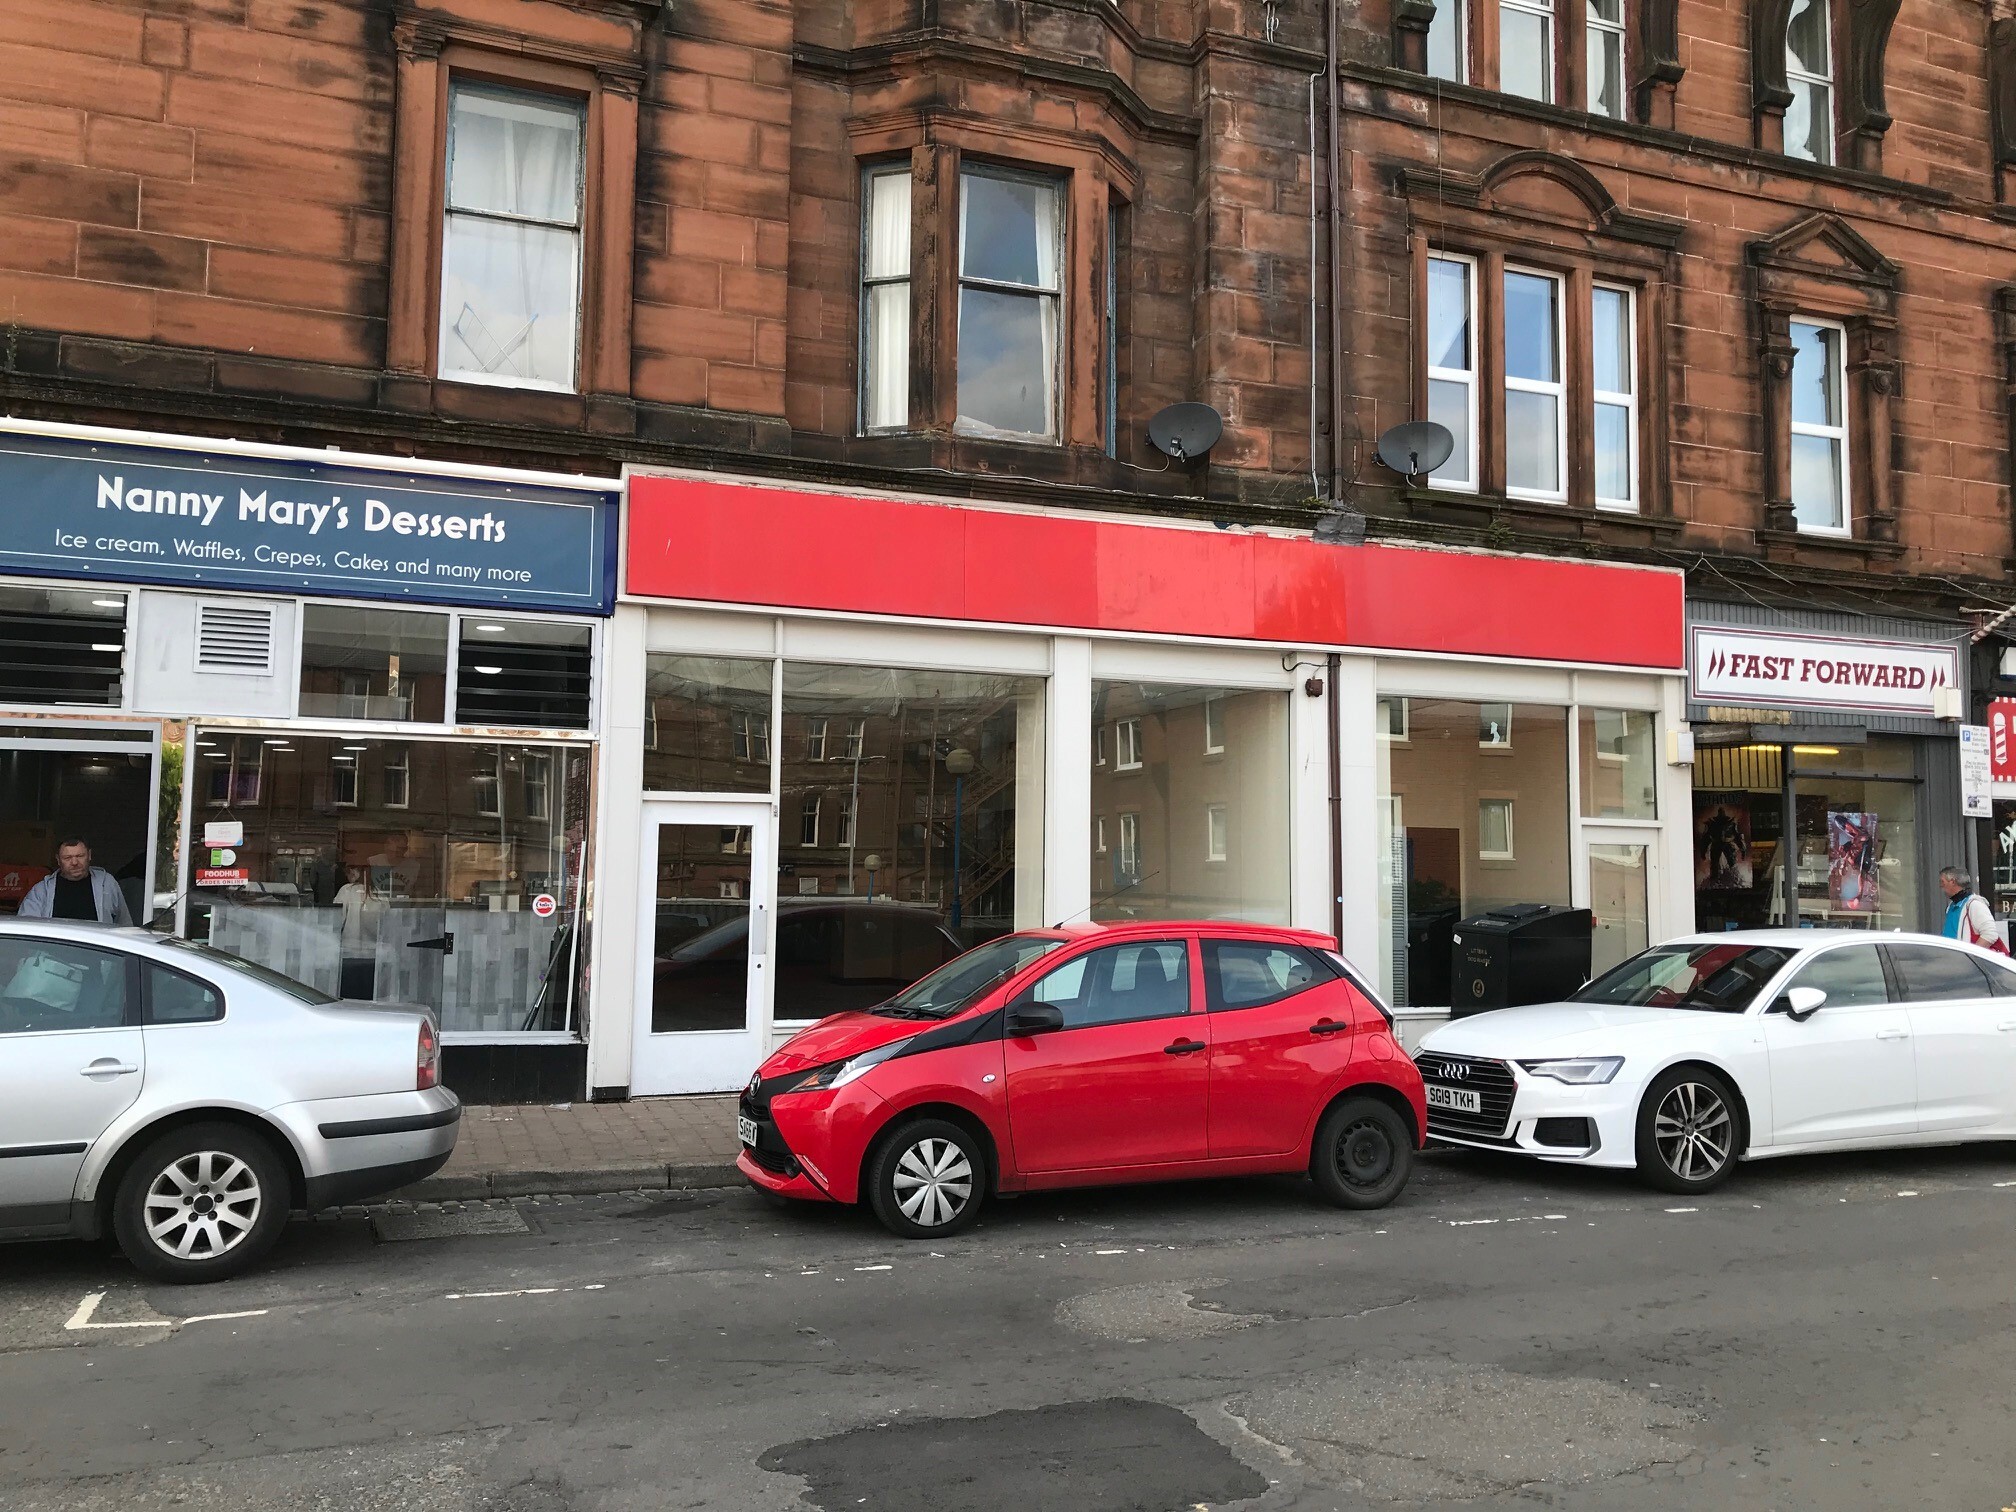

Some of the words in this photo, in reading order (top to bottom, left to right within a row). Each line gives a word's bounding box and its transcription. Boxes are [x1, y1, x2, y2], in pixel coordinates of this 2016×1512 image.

[97, 474, 224, 526] Nanny
[238, 488, 349, 535] Mary's
[365, 499, 506, 543] Desserts
[55, 528, 88, 548] Ice
[95, 536, 165, 556] cream,
[173, 538, 246, 562] Waffles,
[254, 545, 326, 568] Crepes,
[334, 551, 389, 571] Cakes
[395, 558, 430, 575] and
[436, 564, 482, 582] many
[487, 566, 532, 583] more
[1729, 653, 1795, 681] FAST
[1800, 658, 1926, 690] FORWARD
[205, 870, 239, 878] FOODHUB
[1429, 1087, 1451, 1105] SG19
[1453, 1090, 1475, 1109] TKH
